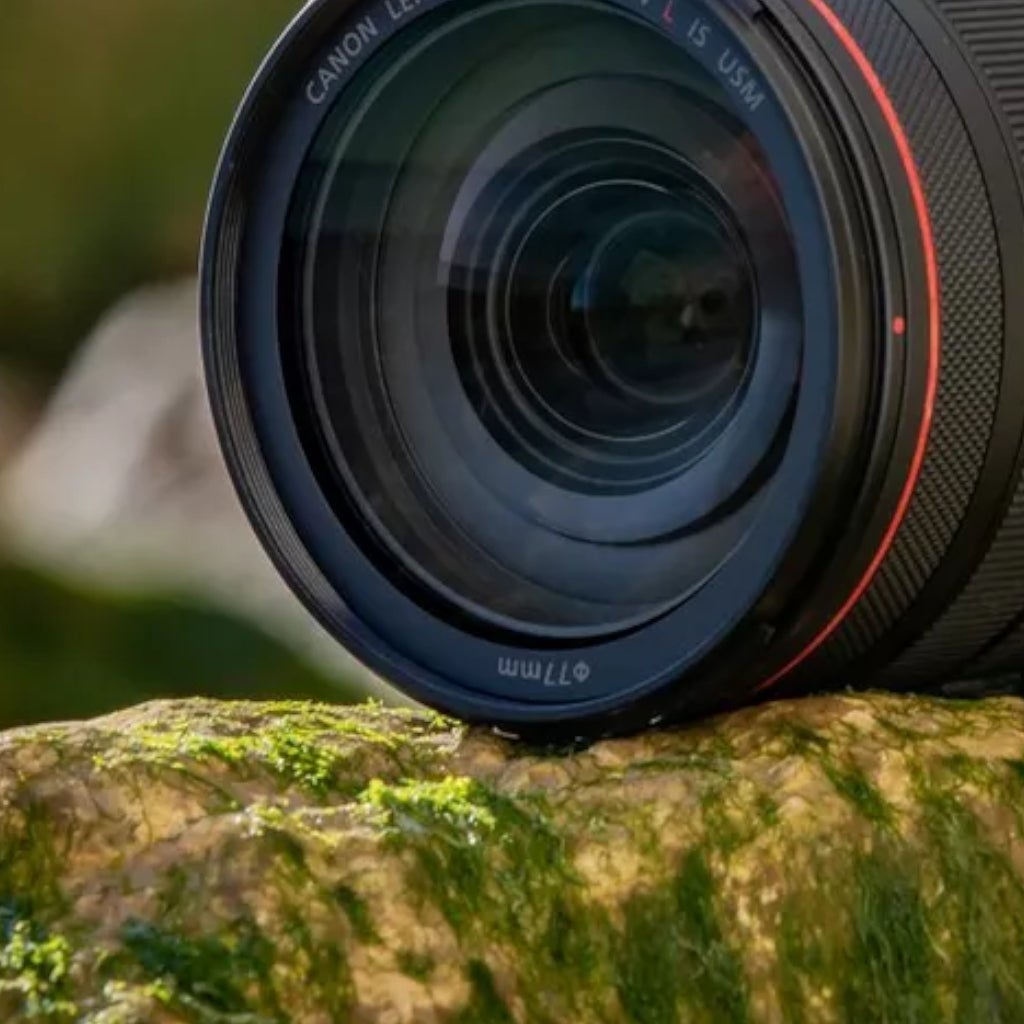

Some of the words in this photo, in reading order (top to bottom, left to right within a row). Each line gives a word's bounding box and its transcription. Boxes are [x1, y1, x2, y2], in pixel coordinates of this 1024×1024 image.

[305, 15, 378, 105] CANON
[662, 0, 675, 23] L
[687, 17, 712, 48] IS
[717, 48, 765, 112] USM
